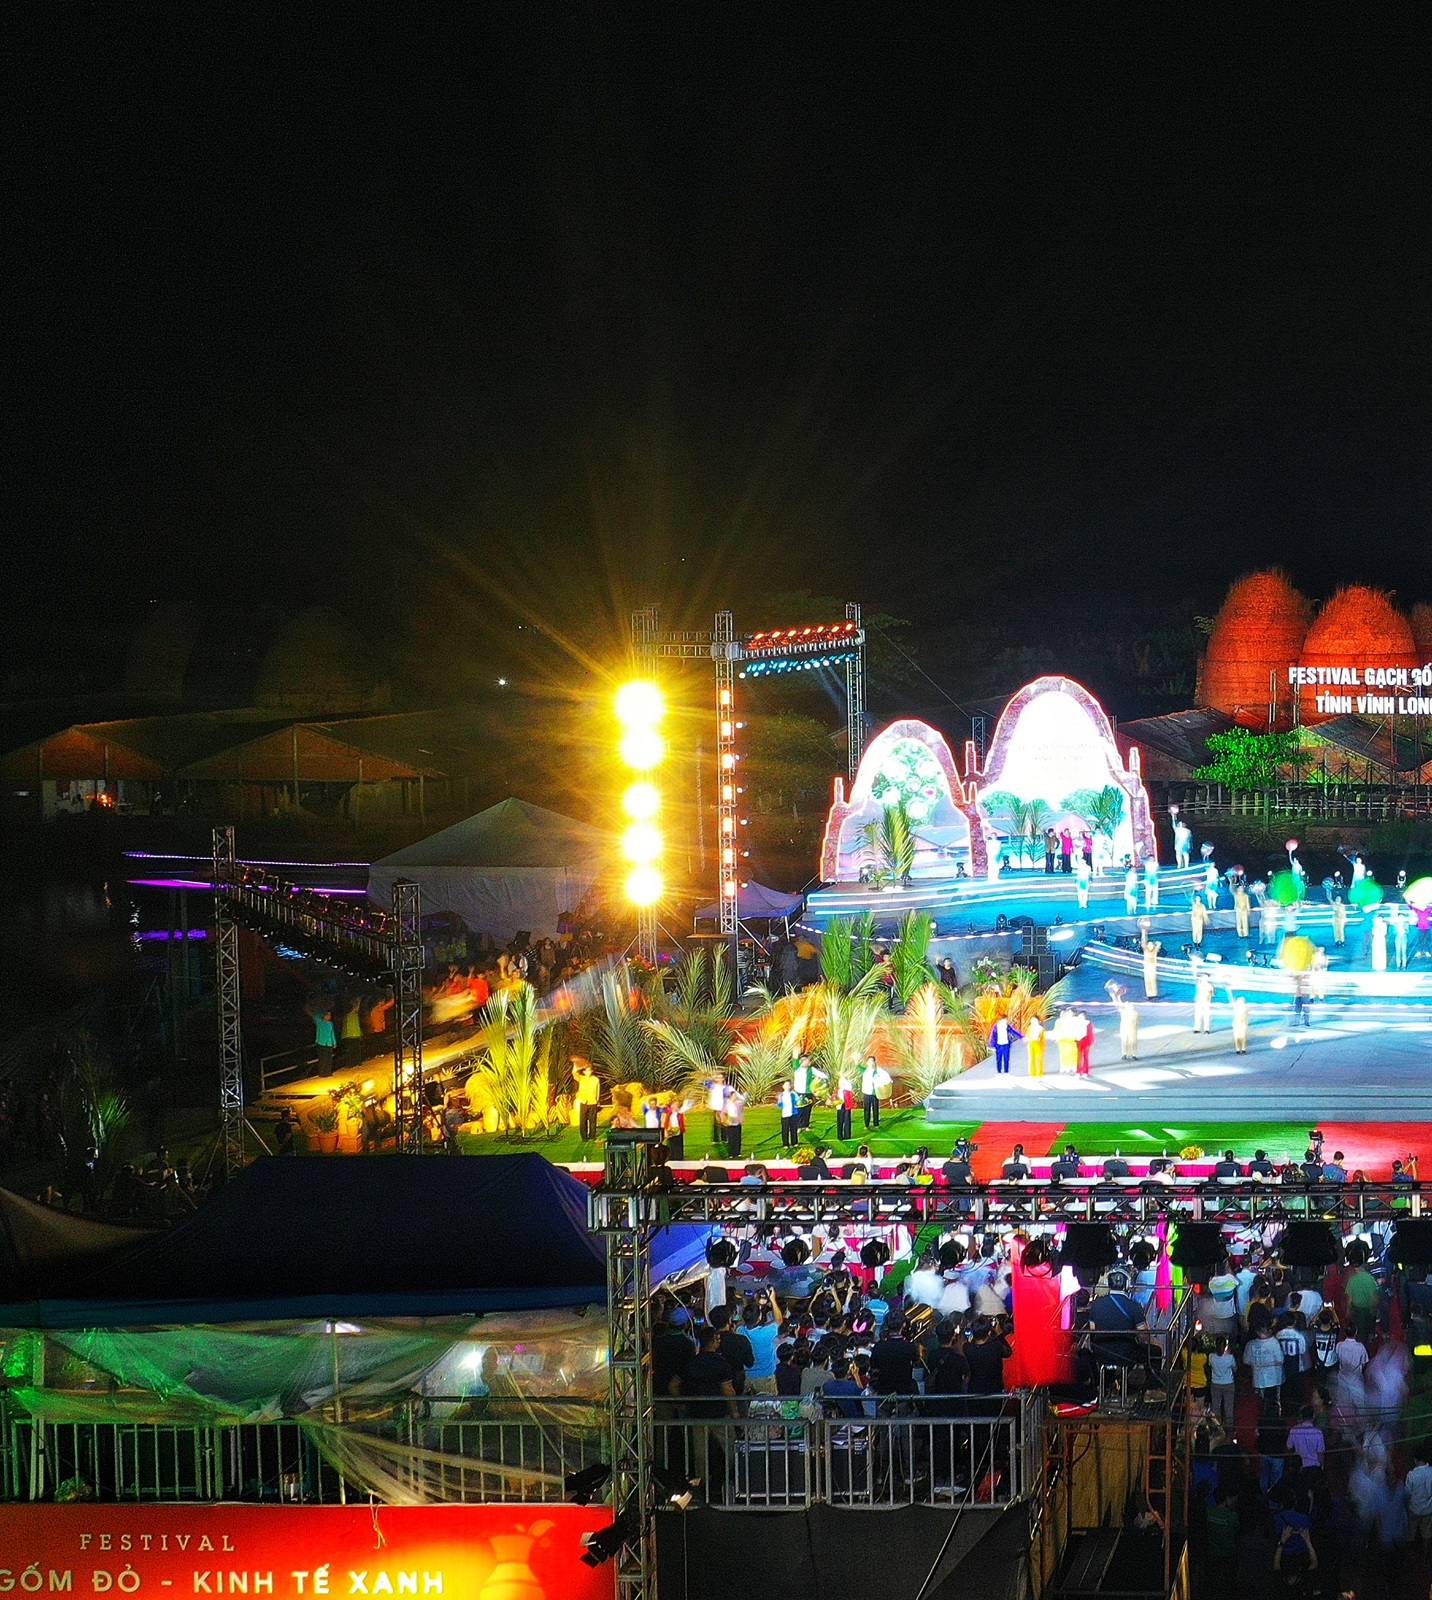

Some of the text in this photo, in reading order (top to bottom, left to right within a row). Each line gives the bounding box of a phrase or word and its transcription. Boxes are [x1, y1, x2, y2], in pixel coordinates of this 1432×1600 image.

[1288, 667, 1361, 685] FESTIVAL
[1365, 668, 1408, 688] GẠCH
[1315, 690, 1352, 714] TỈNH
[1357, 692, 1395, 714] VĨNH
[79, 1533, 235, 1551] FESTIVAL
[0, 1561, 73, 1592] GỐM
[91, 1563, 141, 1593] ĐỎ
[193, 1571, 274, 1594] KINH
[291, 1563, 331, 1594] TẾ
[348, 1571, 444, 1594] XANH
